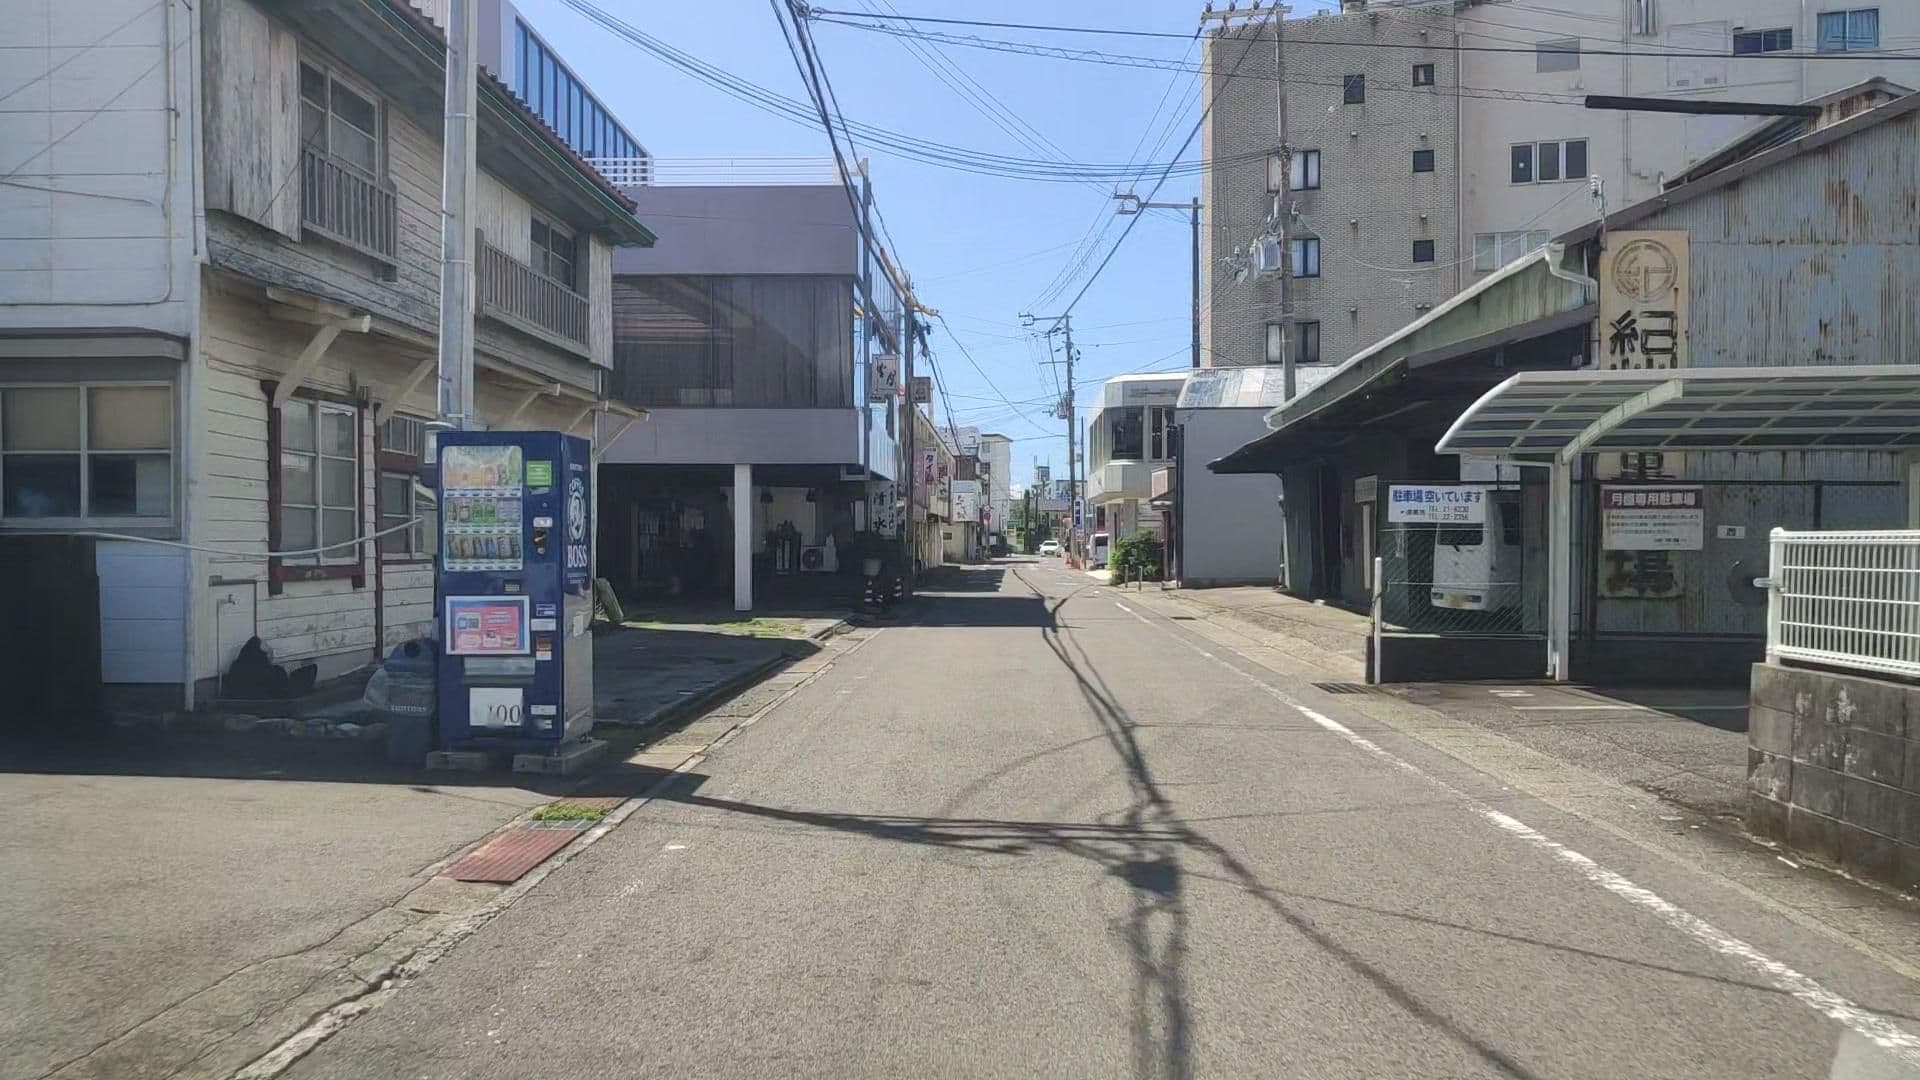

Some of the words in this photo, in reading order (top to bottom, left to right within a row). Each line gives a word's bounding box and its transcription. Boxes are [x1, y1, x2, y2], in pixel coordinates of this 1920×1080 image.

[1609, 310, 1678, 369] 紀
[1392, 489, 1483, 503] 駐車場空いています
[567, 545, 587, 568] BOSS
